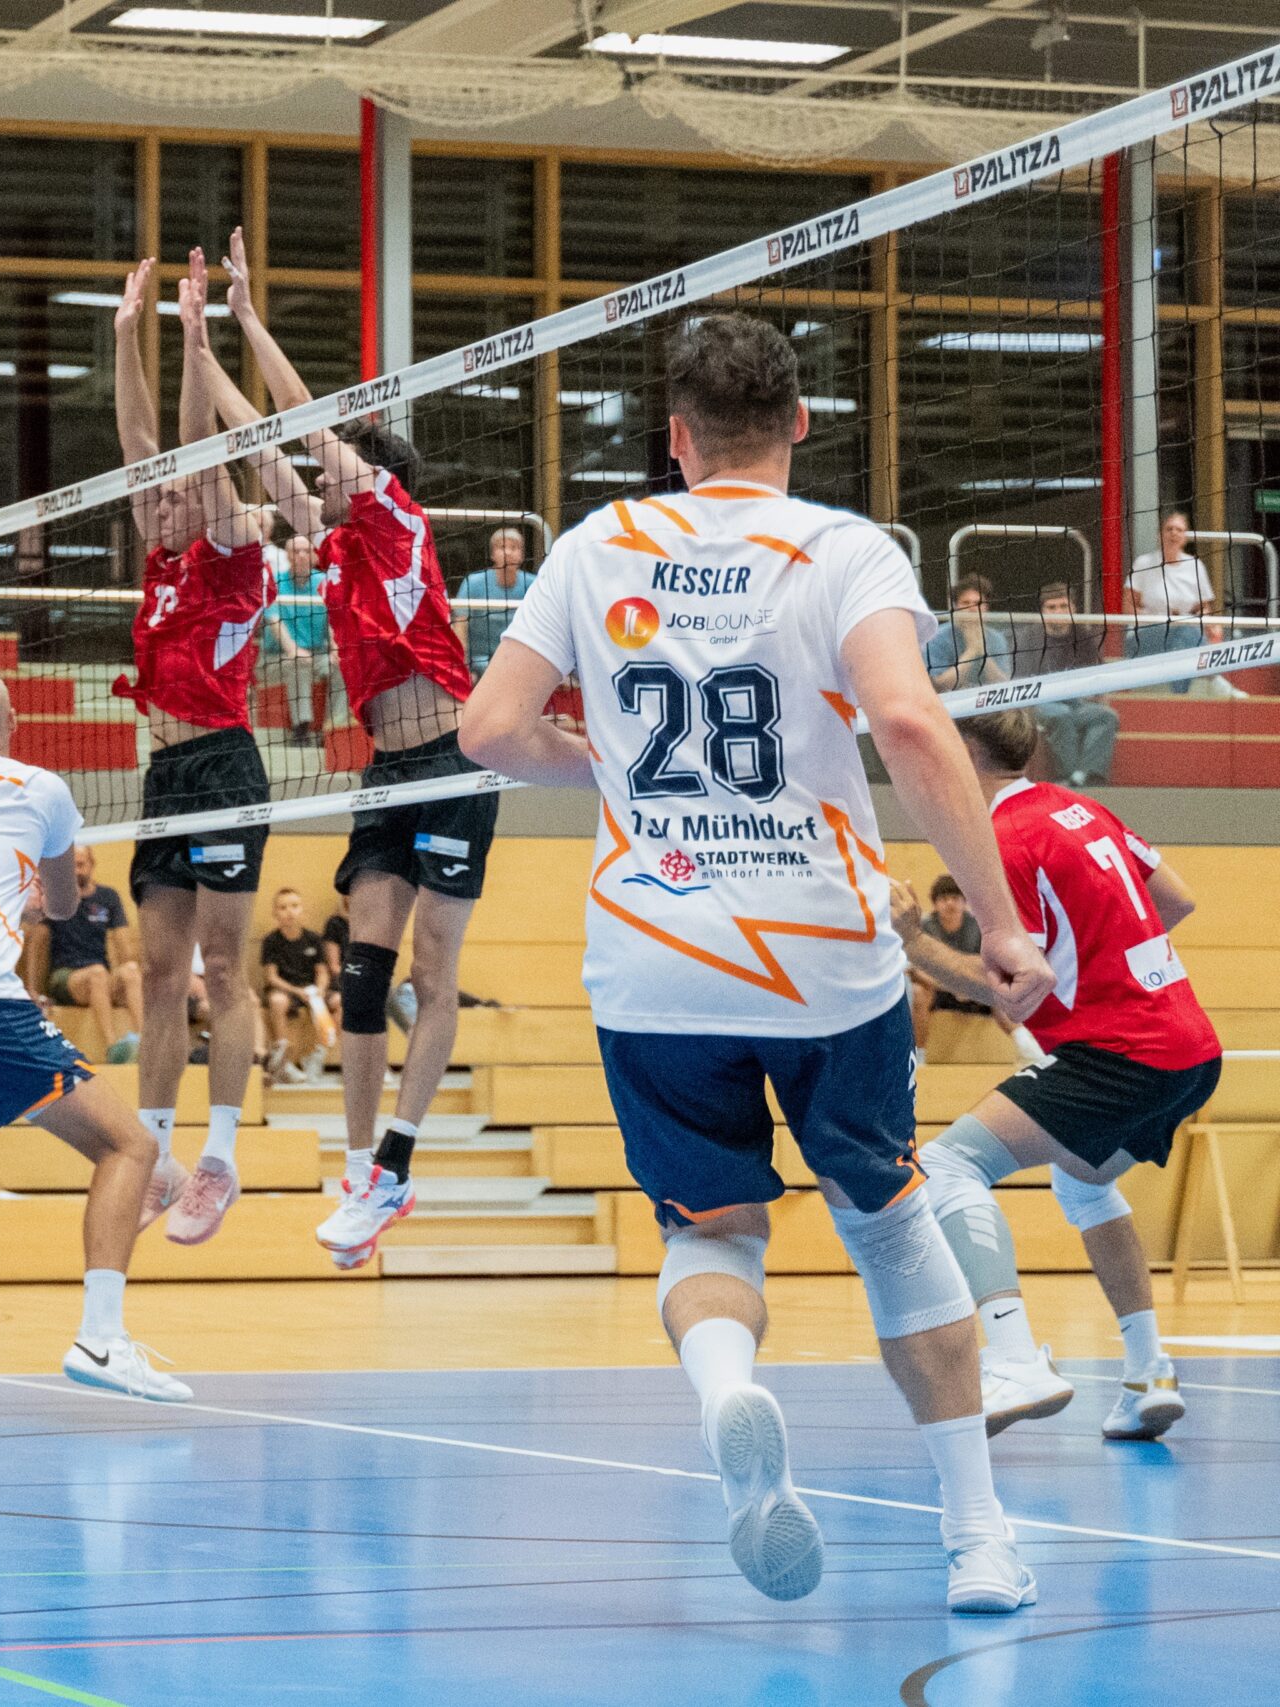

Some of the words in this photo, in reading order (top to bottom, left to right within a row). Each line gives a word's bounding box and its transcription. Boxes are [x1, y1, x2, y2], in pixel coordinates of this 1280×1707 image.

[1190, 54, 1280, 112] PALITZ
[971, 135, 1061, 192] PALITZA
[782, 209, 859, 260] PALITZA
[620, 273, 685, 318] PALITZA
[475, 328, 534, 368] PALITZA
[348, 375, 401, 412] PALITZA
[236, 418, 283, 449] PALITZA
[135, 455, 177, 485] PALITZA
[652, 561, 751, 596] KESSLER
[710, 635, 738, 645] GmbH
[1209, 640, 1274, 669] PALITZA
[985, 682, 1042, 707] PALITZA
[611, 661, 786, 804] 28
[695, 851, 810, 866] STADTWERKE
[701, 868, 761, 880] mühldorf
[767, 870, 785, 878] am
[792, 868, 813, 879] inn
[1084, 836, 1148, 921] 7
